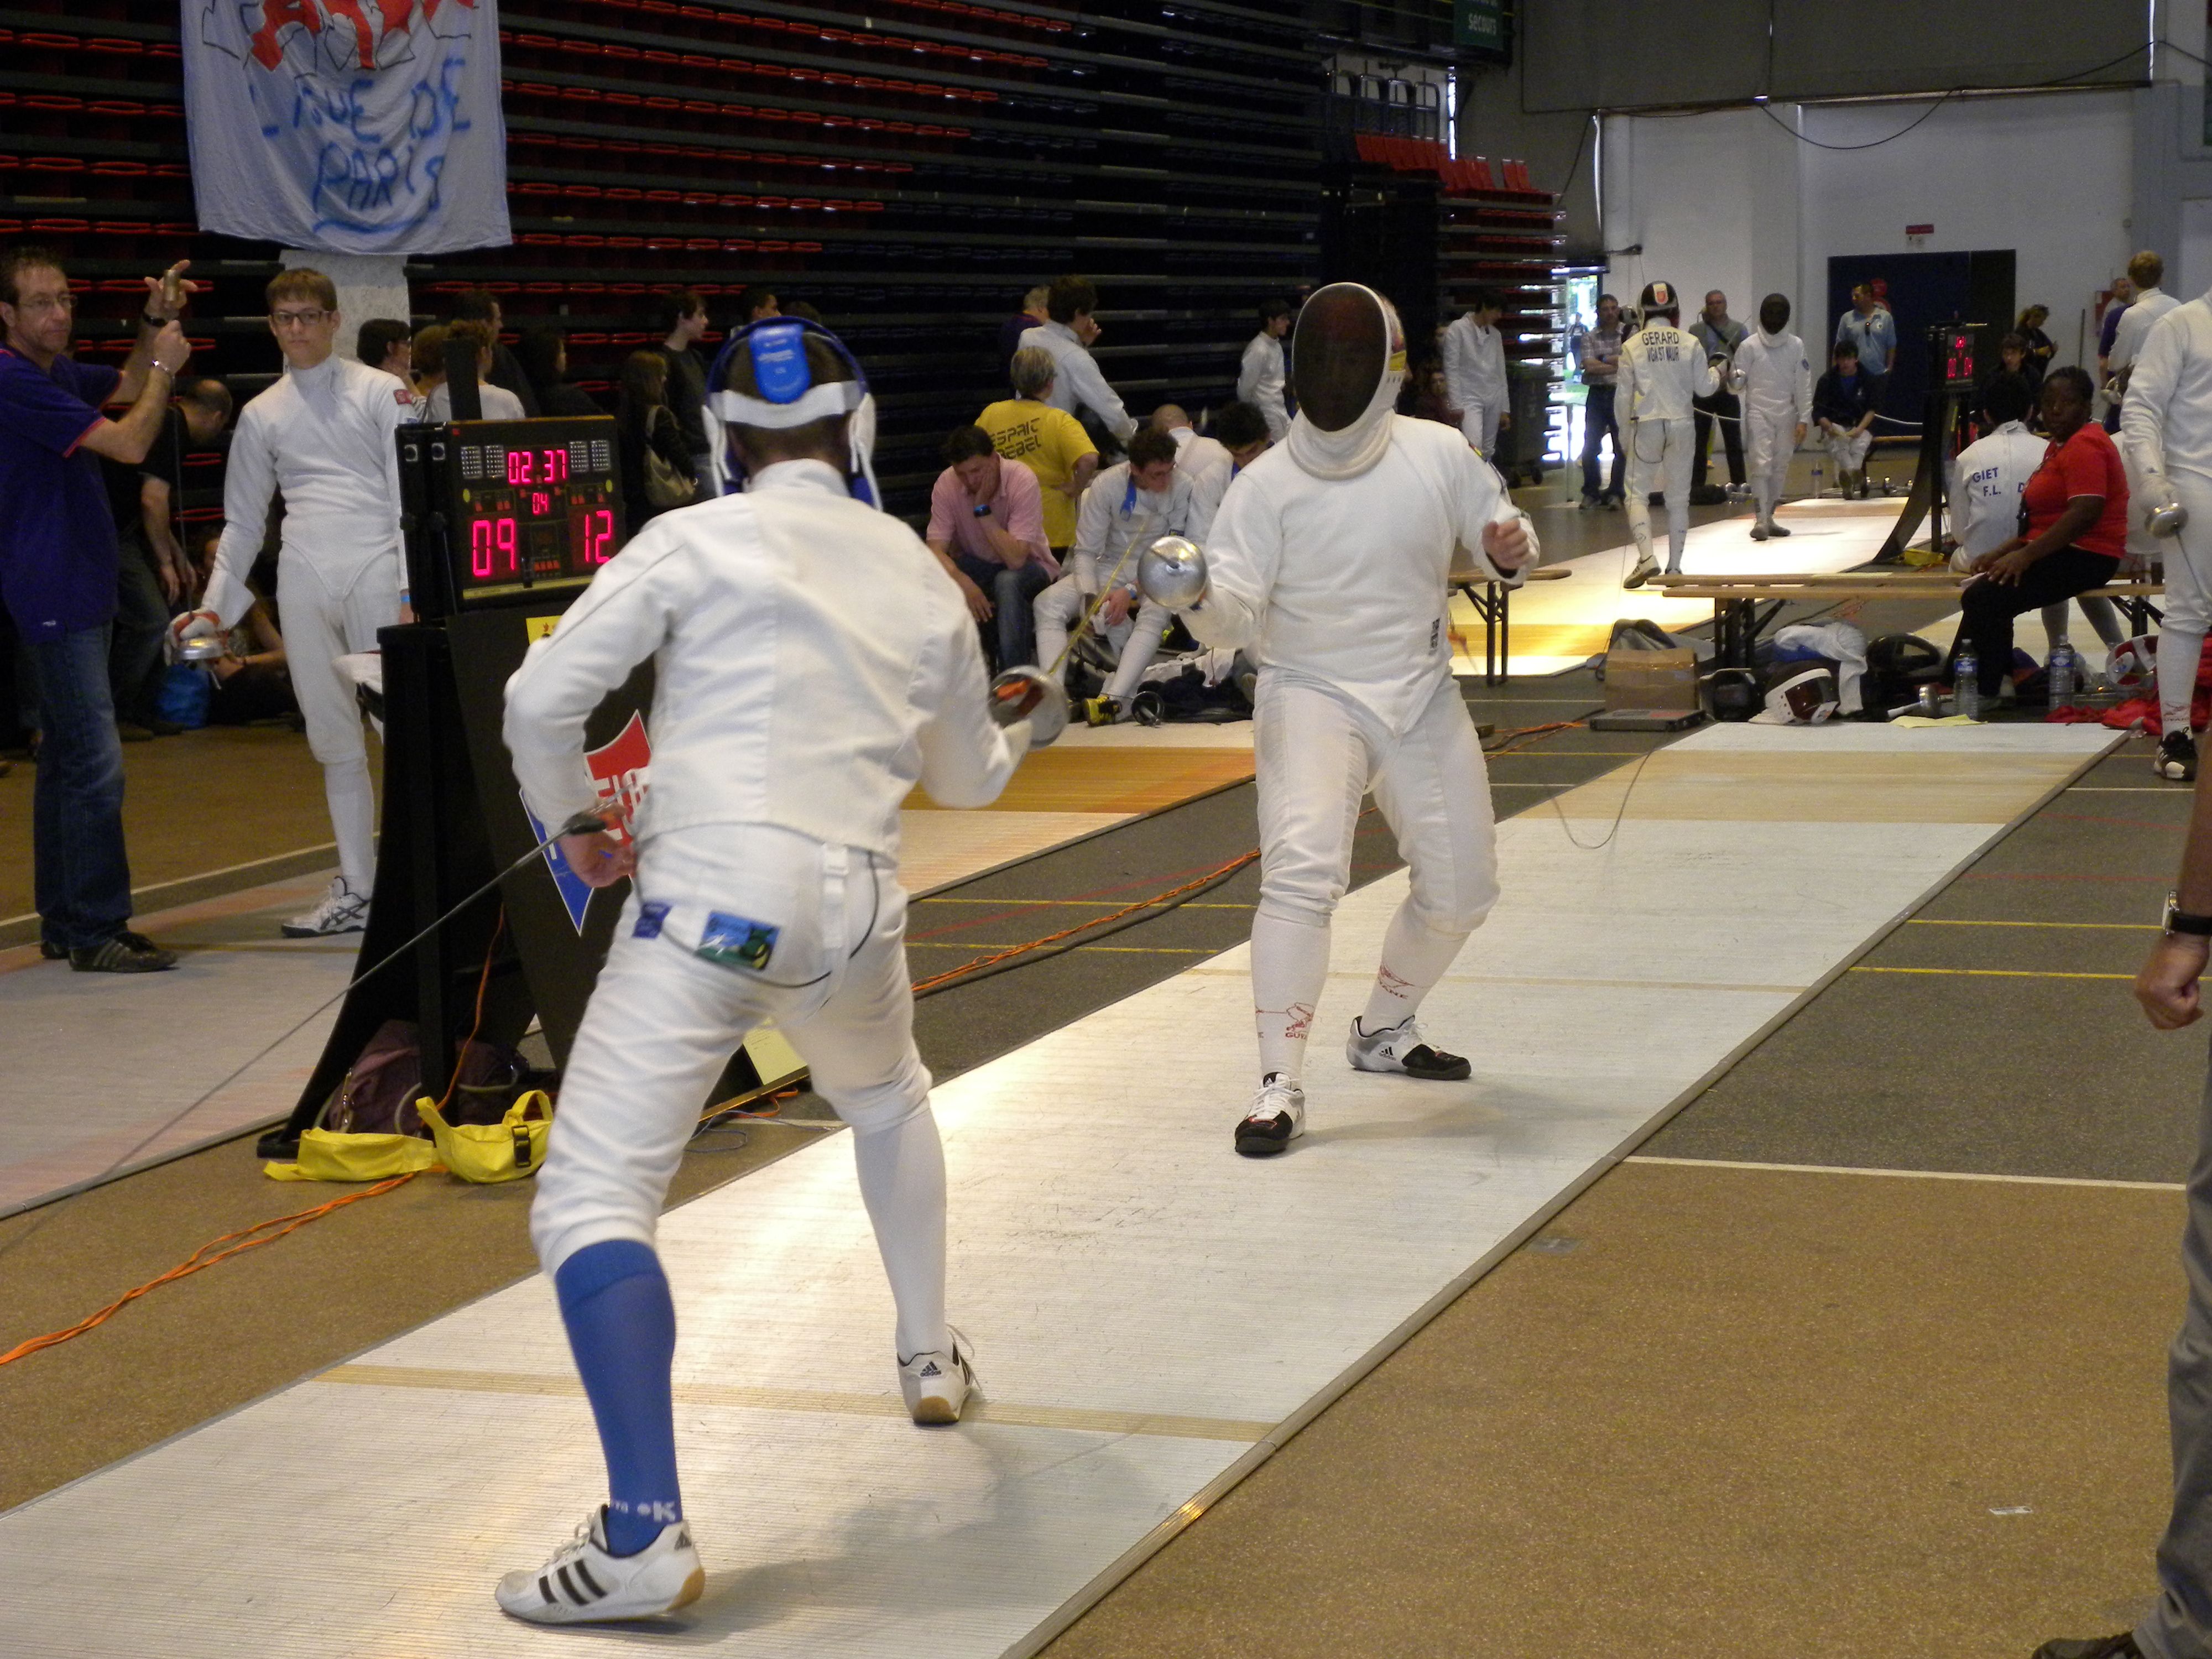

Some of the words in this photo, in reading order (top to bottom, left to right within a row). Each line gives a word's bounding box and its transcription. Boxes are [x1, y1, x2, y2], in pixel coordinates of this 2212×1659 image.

[1641, 331, 1679, 346] GERARD
[1972, 467, 1998, 483] GIET
[532, 492, 549, 515] 04
[472, 517, 515, 577] 09
[584, 510, 613, 564] 12
